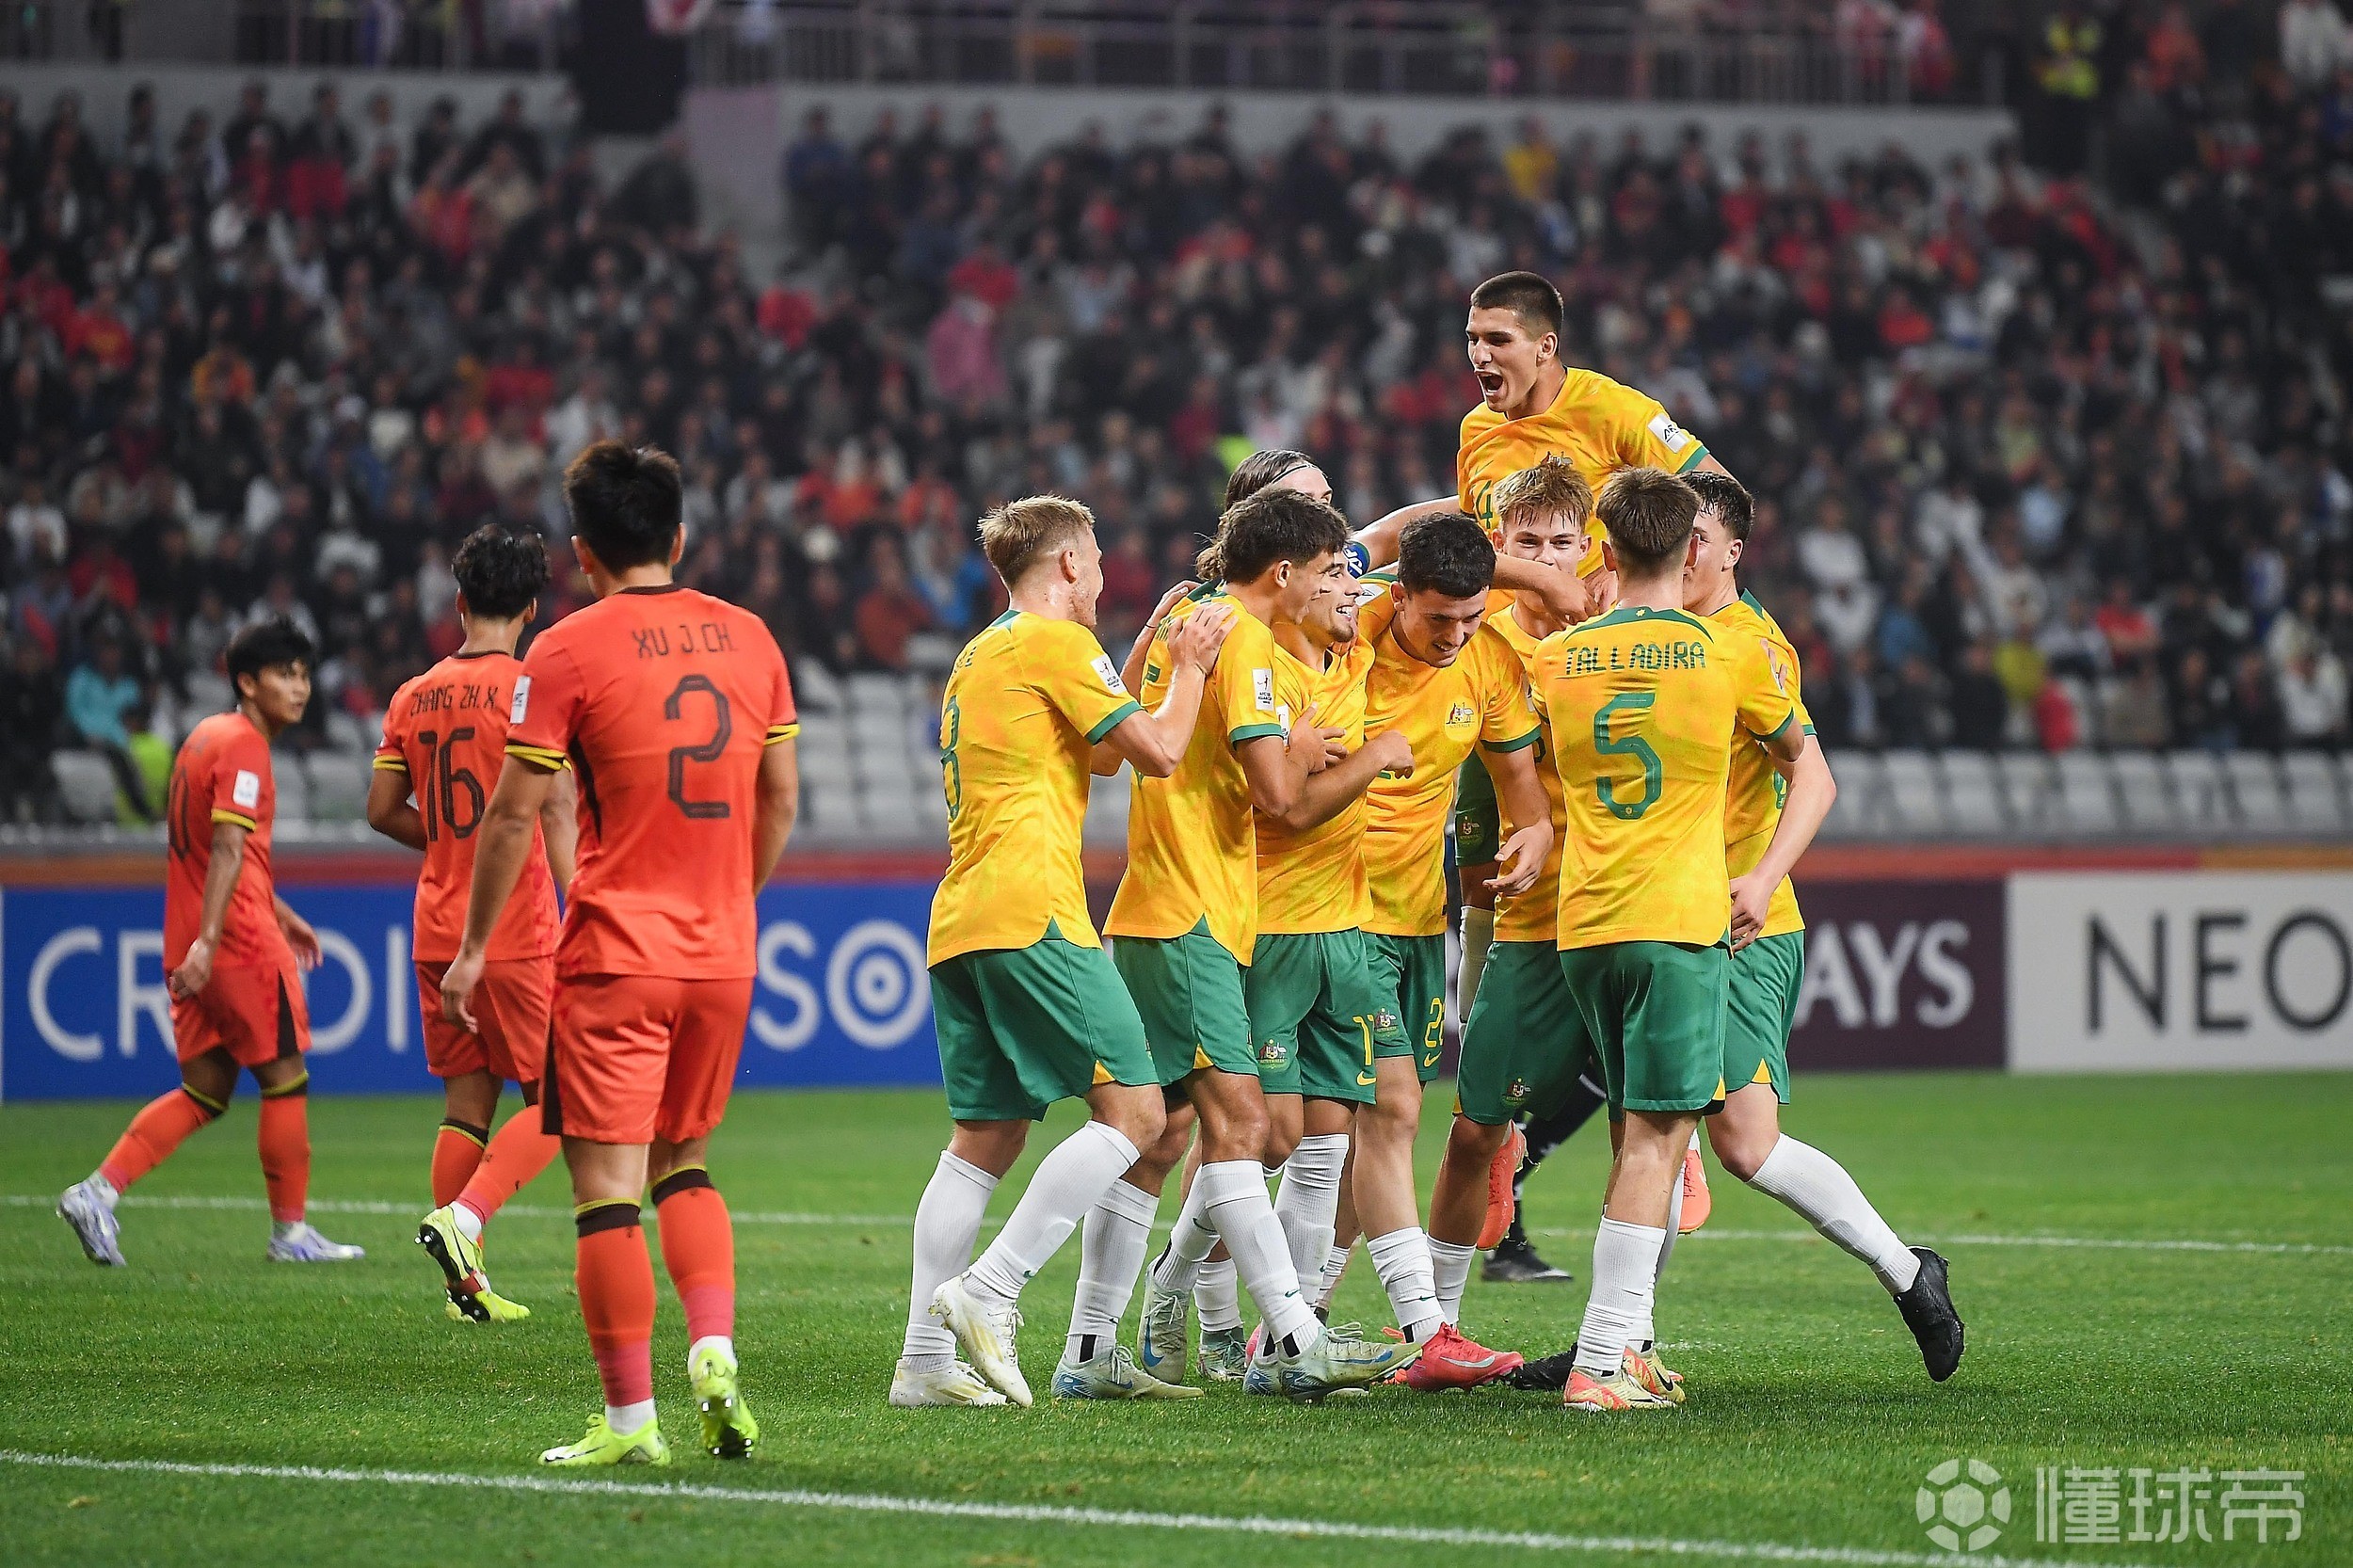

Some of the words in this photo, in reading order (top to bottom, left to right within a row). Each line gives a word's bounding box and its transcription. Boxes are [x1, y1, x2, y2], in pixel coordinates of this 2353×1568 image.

[410, 685, 456, 717] ZHANG
[632, 628, 669, 659] XU
[1565, 641, 1706, 676] TALLADIRA
[418, 727, 486, 842] 16
[664, 674, 732, 819] 2
[1593, 692, 1663, 821] 5
[27, 926, 410, 1062] CRDI
[1790, 920, 1974, 1031] AYS
[2086, 907, 2353, 1034] NEO
